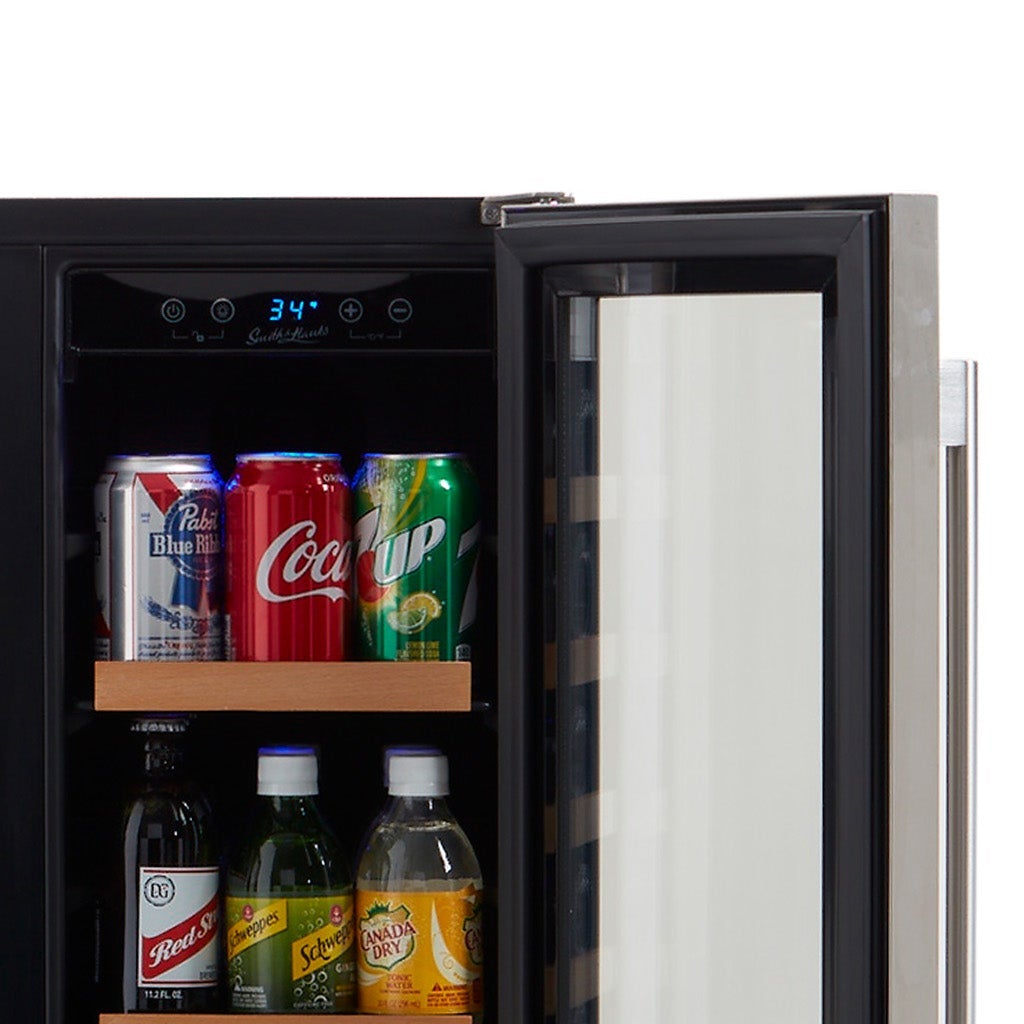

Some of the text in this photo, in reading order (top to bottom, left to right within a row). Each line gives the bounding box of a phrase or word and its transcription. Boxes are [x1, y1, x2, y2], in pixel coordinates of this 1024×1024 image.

[151, 534, 194, 555] Blue
[148, 926, 197, 968] Red
[361, 920, 416, 951] CANADA
[373, 940, 401, 960] DRY
